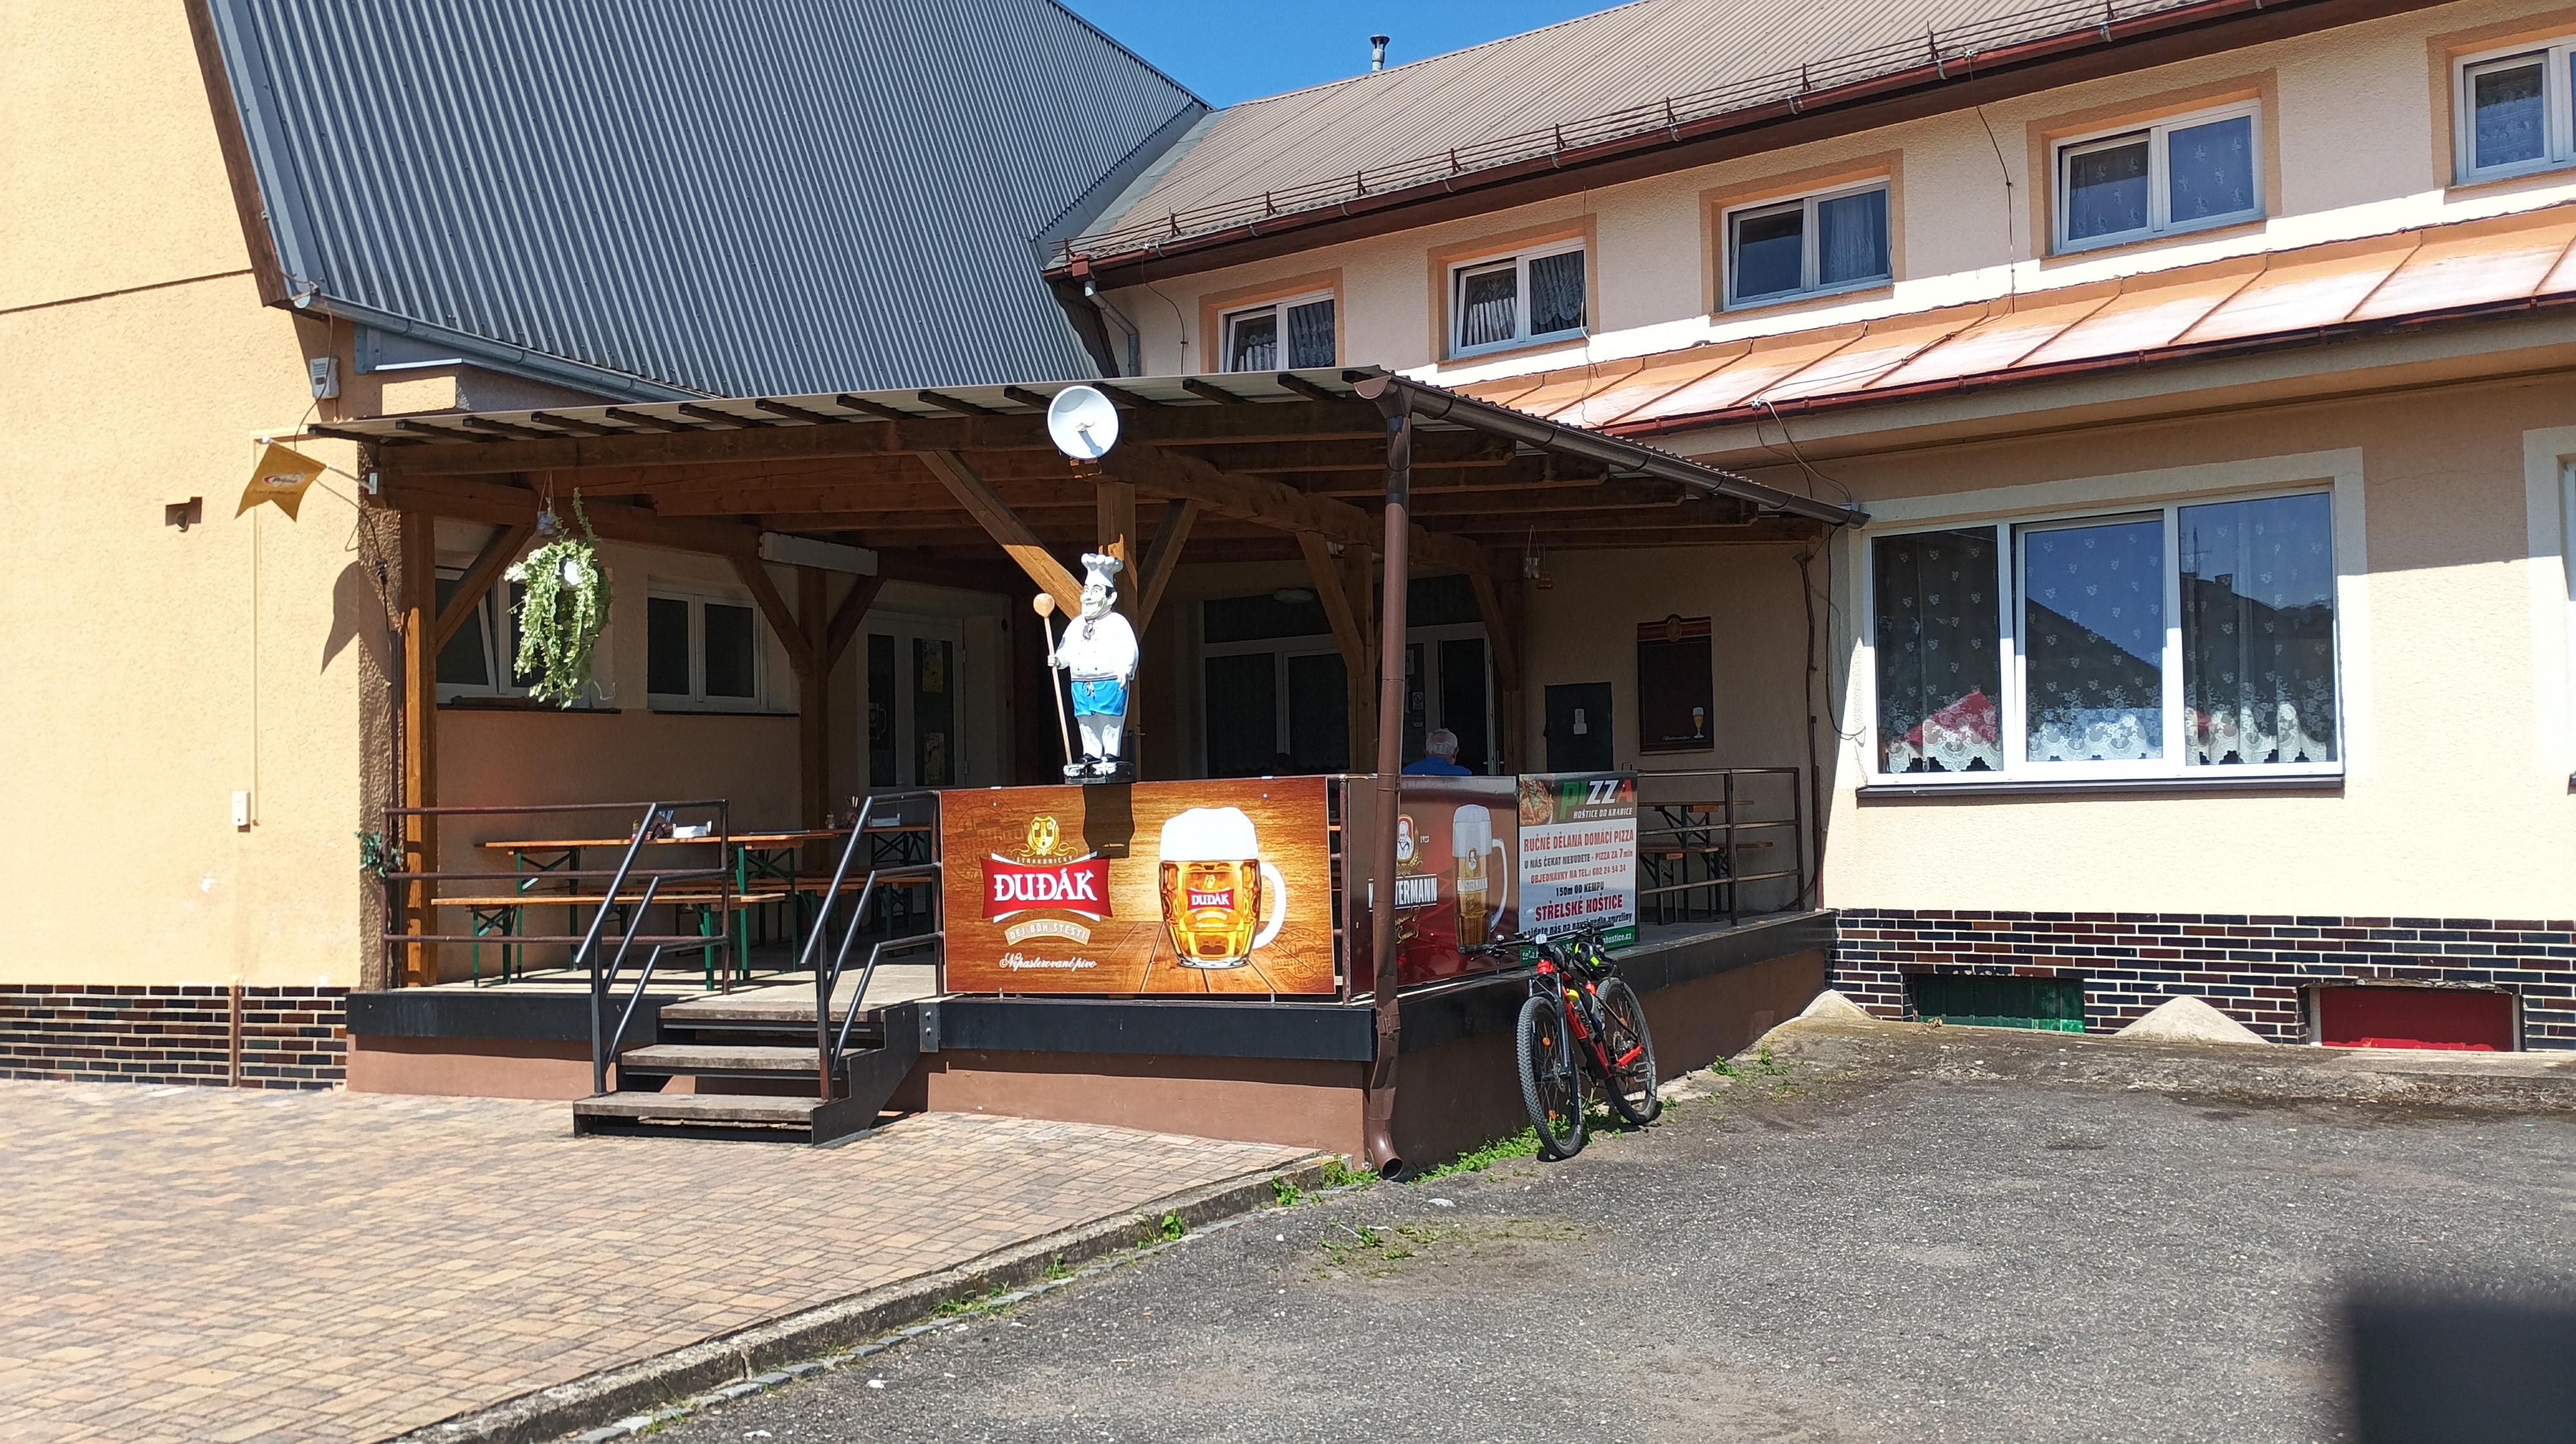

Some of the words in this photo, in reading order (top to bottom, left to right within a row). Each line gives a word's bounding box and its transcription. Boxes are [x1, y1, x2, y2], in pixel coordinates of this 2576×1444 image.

[1559, 779, 1634, 820] PIZZA
[1573, 809, 1598, 819] HOŠTICE
[1608, 807, 1633, 816] KRABICE
[1524, 832, 1550, 852] RUČNĚ
[1553, 830, 1582, 849] DĚLANÁ
[1585, 827, 1612, 846] DOMÁCÍ
[1615, 829, 1634, 843] PIZZA
[1524, 861, 1529, 869] U
[1530, 856, 1542, 868] NÁS
[1544, 856, 1561, 867] ČEKAT
[1563, 854, 1590, 865] NEBUDETE
[1595, 851, 1610, 861] PIZZA
[1611, 850, 1618, 859] ZA
[1620, 848, 1624, 858] 7
[994, 867, 1097, 902] DUDÁK
[1531, 869, 1568, 884] OBJEDNÁVKY
[1569, 870, 1577, 879] NA
[1556, 886, 1573, 897] 150m
[1574, 885, 1582, 894] OD
[1584, 881, 1604, 893] KEMPU
[1535, 895, 1583, 922] STŘELSKÉ
[1586, 893, 1623, 914] HOŠTICE
[1010, 926, 1025, 939] DEJ
[1549, 923, 1561, 935] nás
[1563, 923, 1571, 932] na
[1071, 957, 1097, 971] pivo
